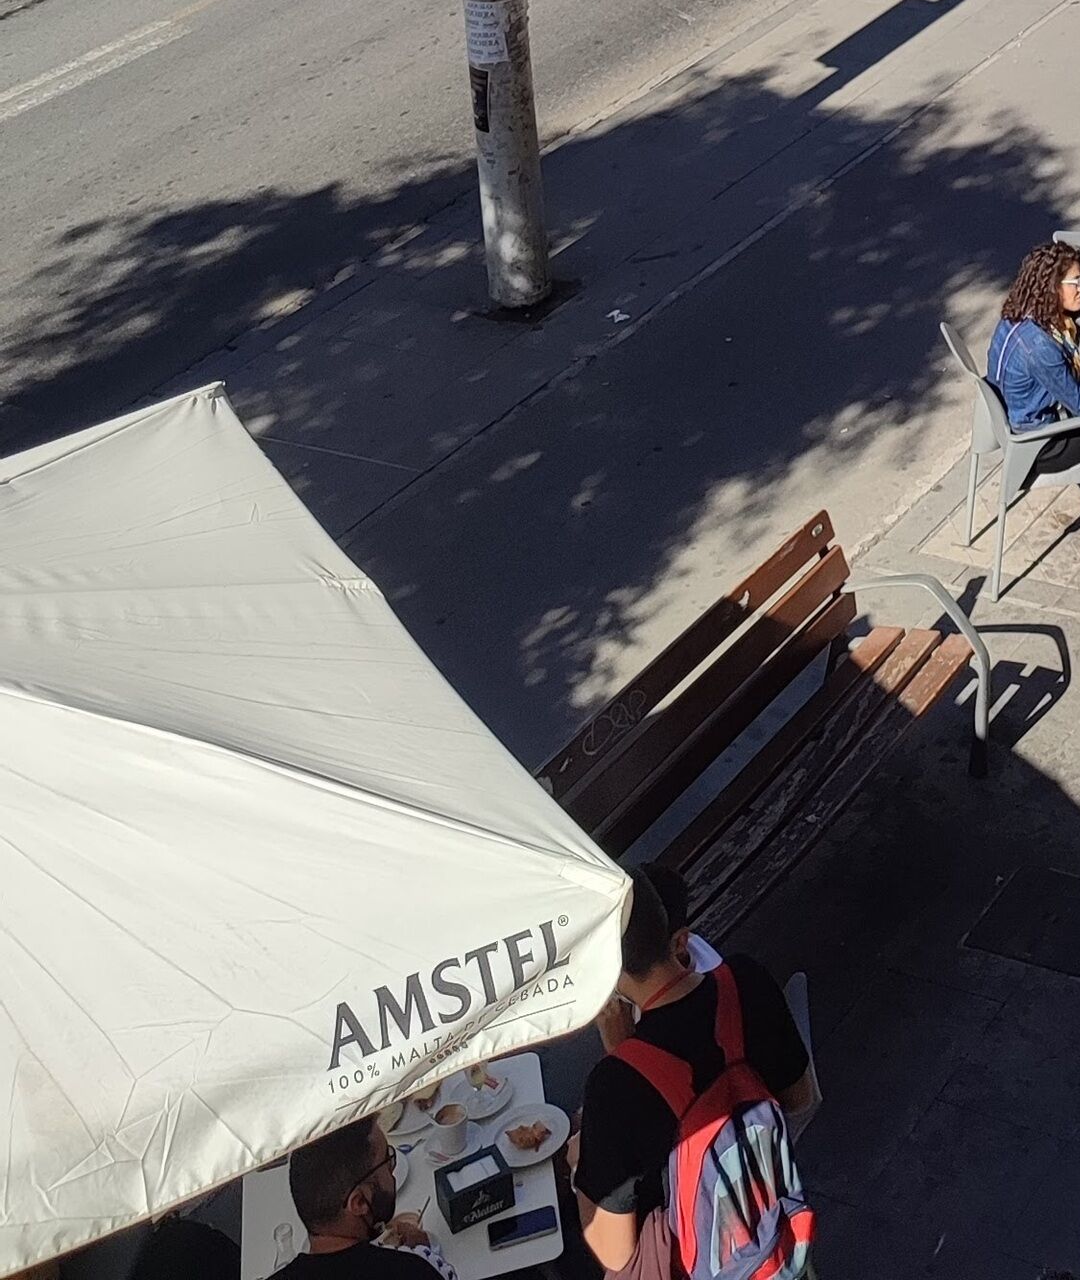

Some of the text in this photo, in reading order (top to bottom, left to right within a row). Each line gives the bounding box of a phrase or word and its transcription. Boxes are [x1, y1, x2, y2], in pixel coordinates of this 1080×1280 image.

[326, 919, 571, 1071] AMSTEL
[328, 1062, 380, 1094] 100%
[495, 974, 575, 1012] CEBADA
